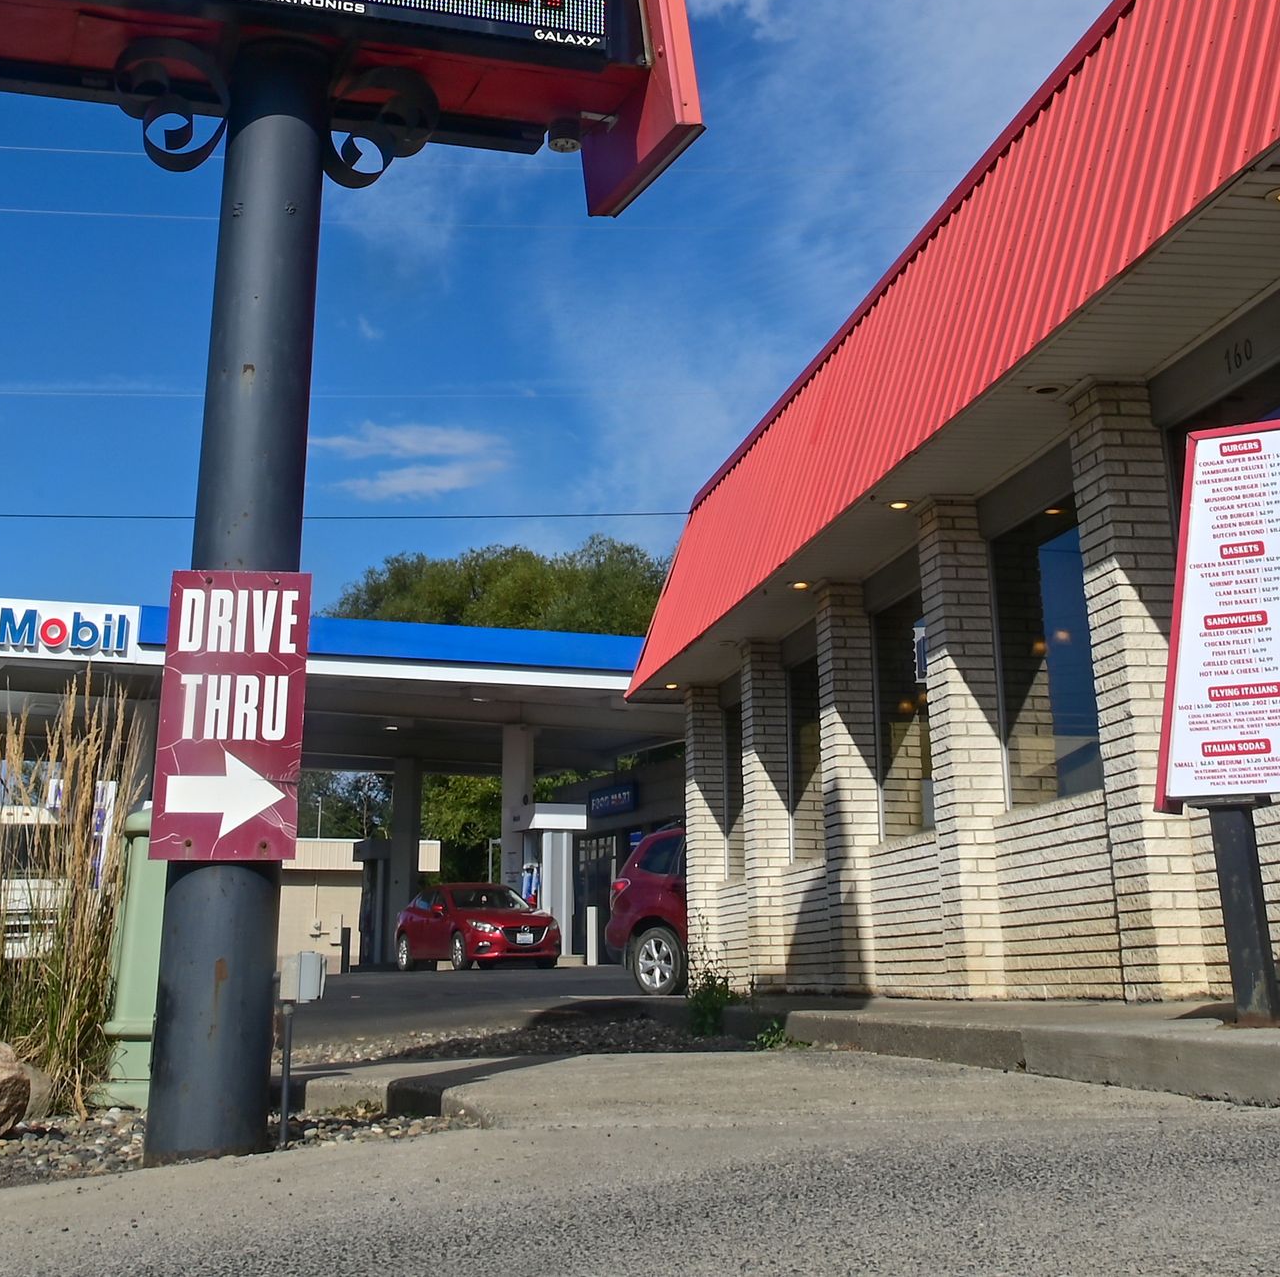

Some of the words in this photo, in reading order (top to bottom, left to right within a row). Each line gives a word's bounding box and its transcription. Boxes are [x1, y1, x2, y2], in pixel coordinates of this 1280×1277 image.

[534, 28, 600, 46] GALAXY
[1224, 338, 1252, 374] 160
[1222, 442, 1258, 452] BURGERS
[1202, 467, 1239, 475] HAMBURGER
[1204, 495, 1240, 503] MUSHROOM
[1223, 545, 1258, 554] BASKETS
[178, 588, 299, 653] DRIVE
[1207, 615, 1261, 625] SANDWICHES
[1211, 689, 1238, 697] FLYING
[1242, 686, 1277, 694] ITALIANS
[181, 675, 289, 741] THRU
[1205, 744, 1235, 752] ITALIAN
